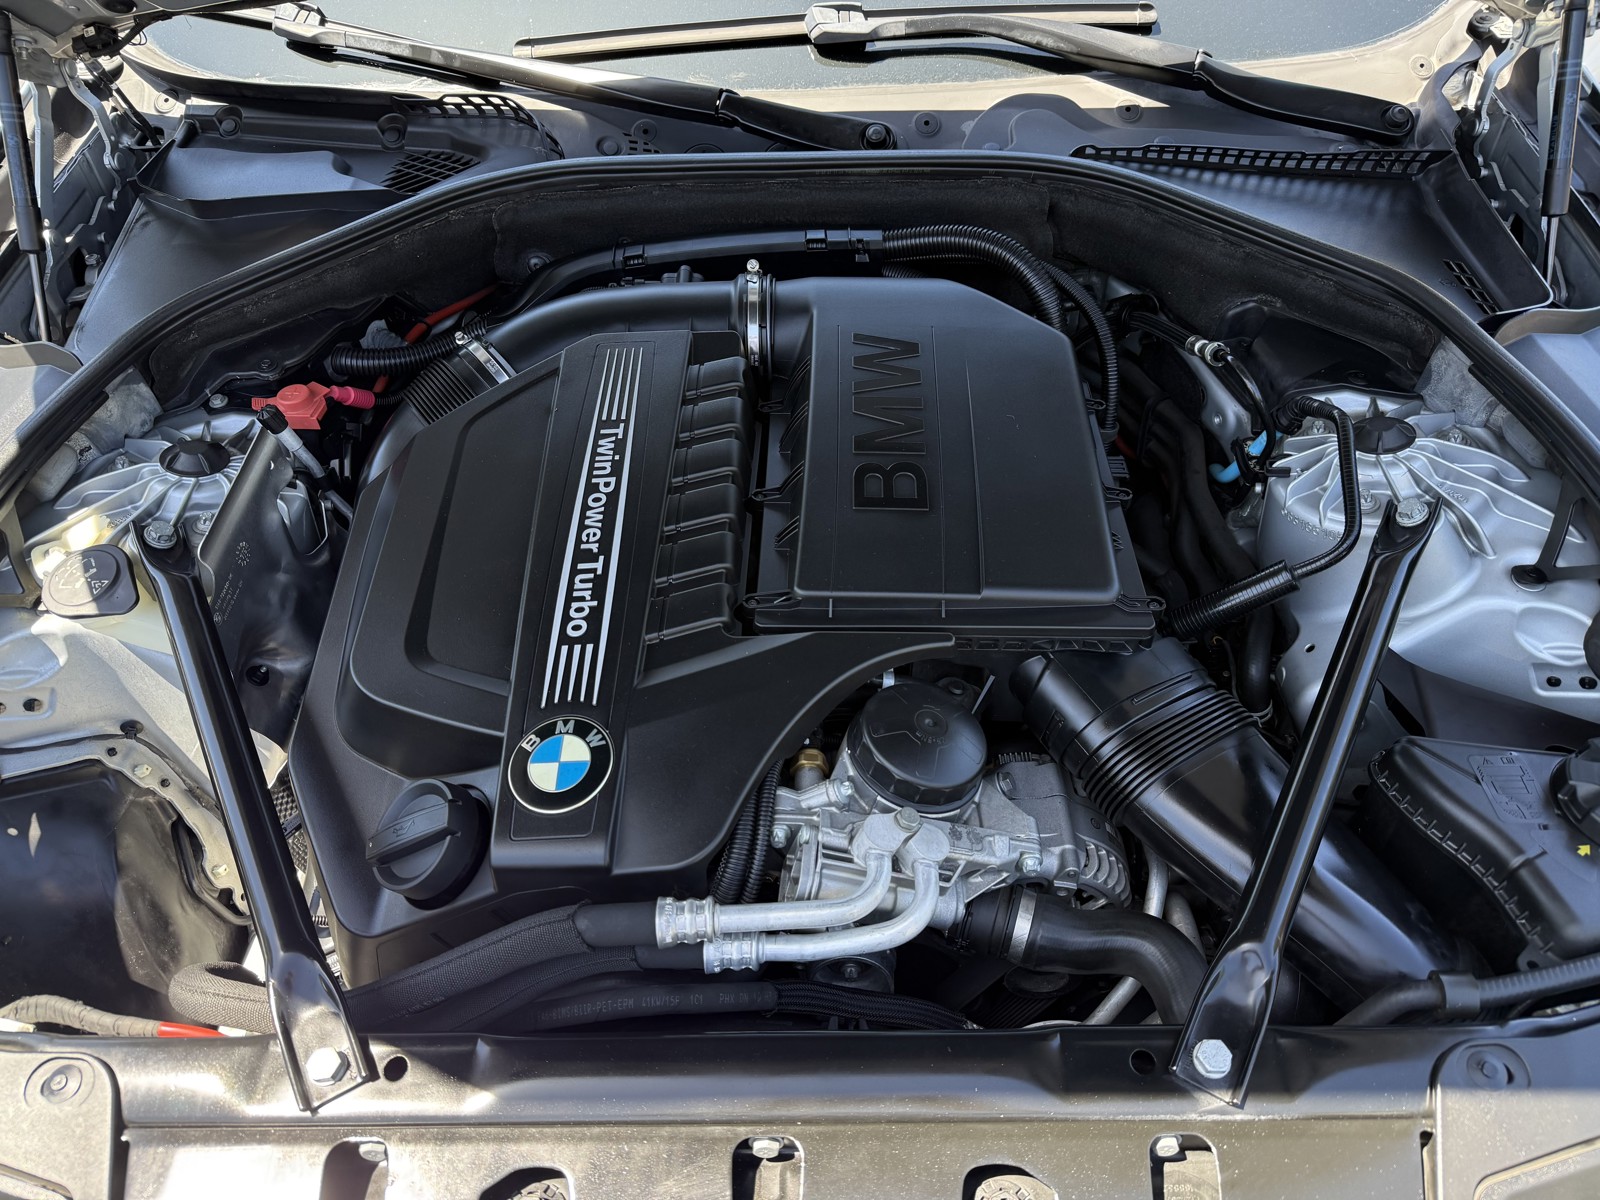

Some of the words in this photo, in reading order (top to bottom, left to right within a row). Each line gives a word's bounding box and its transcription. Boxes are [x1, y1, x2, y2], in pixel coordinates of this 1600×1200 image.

[852, 332, 930, 511] BMW
[580, 422, 625, 553] TwinPower
[566, 555, 605, 638] Turbo
[521, 719, 607, 752] BMW
